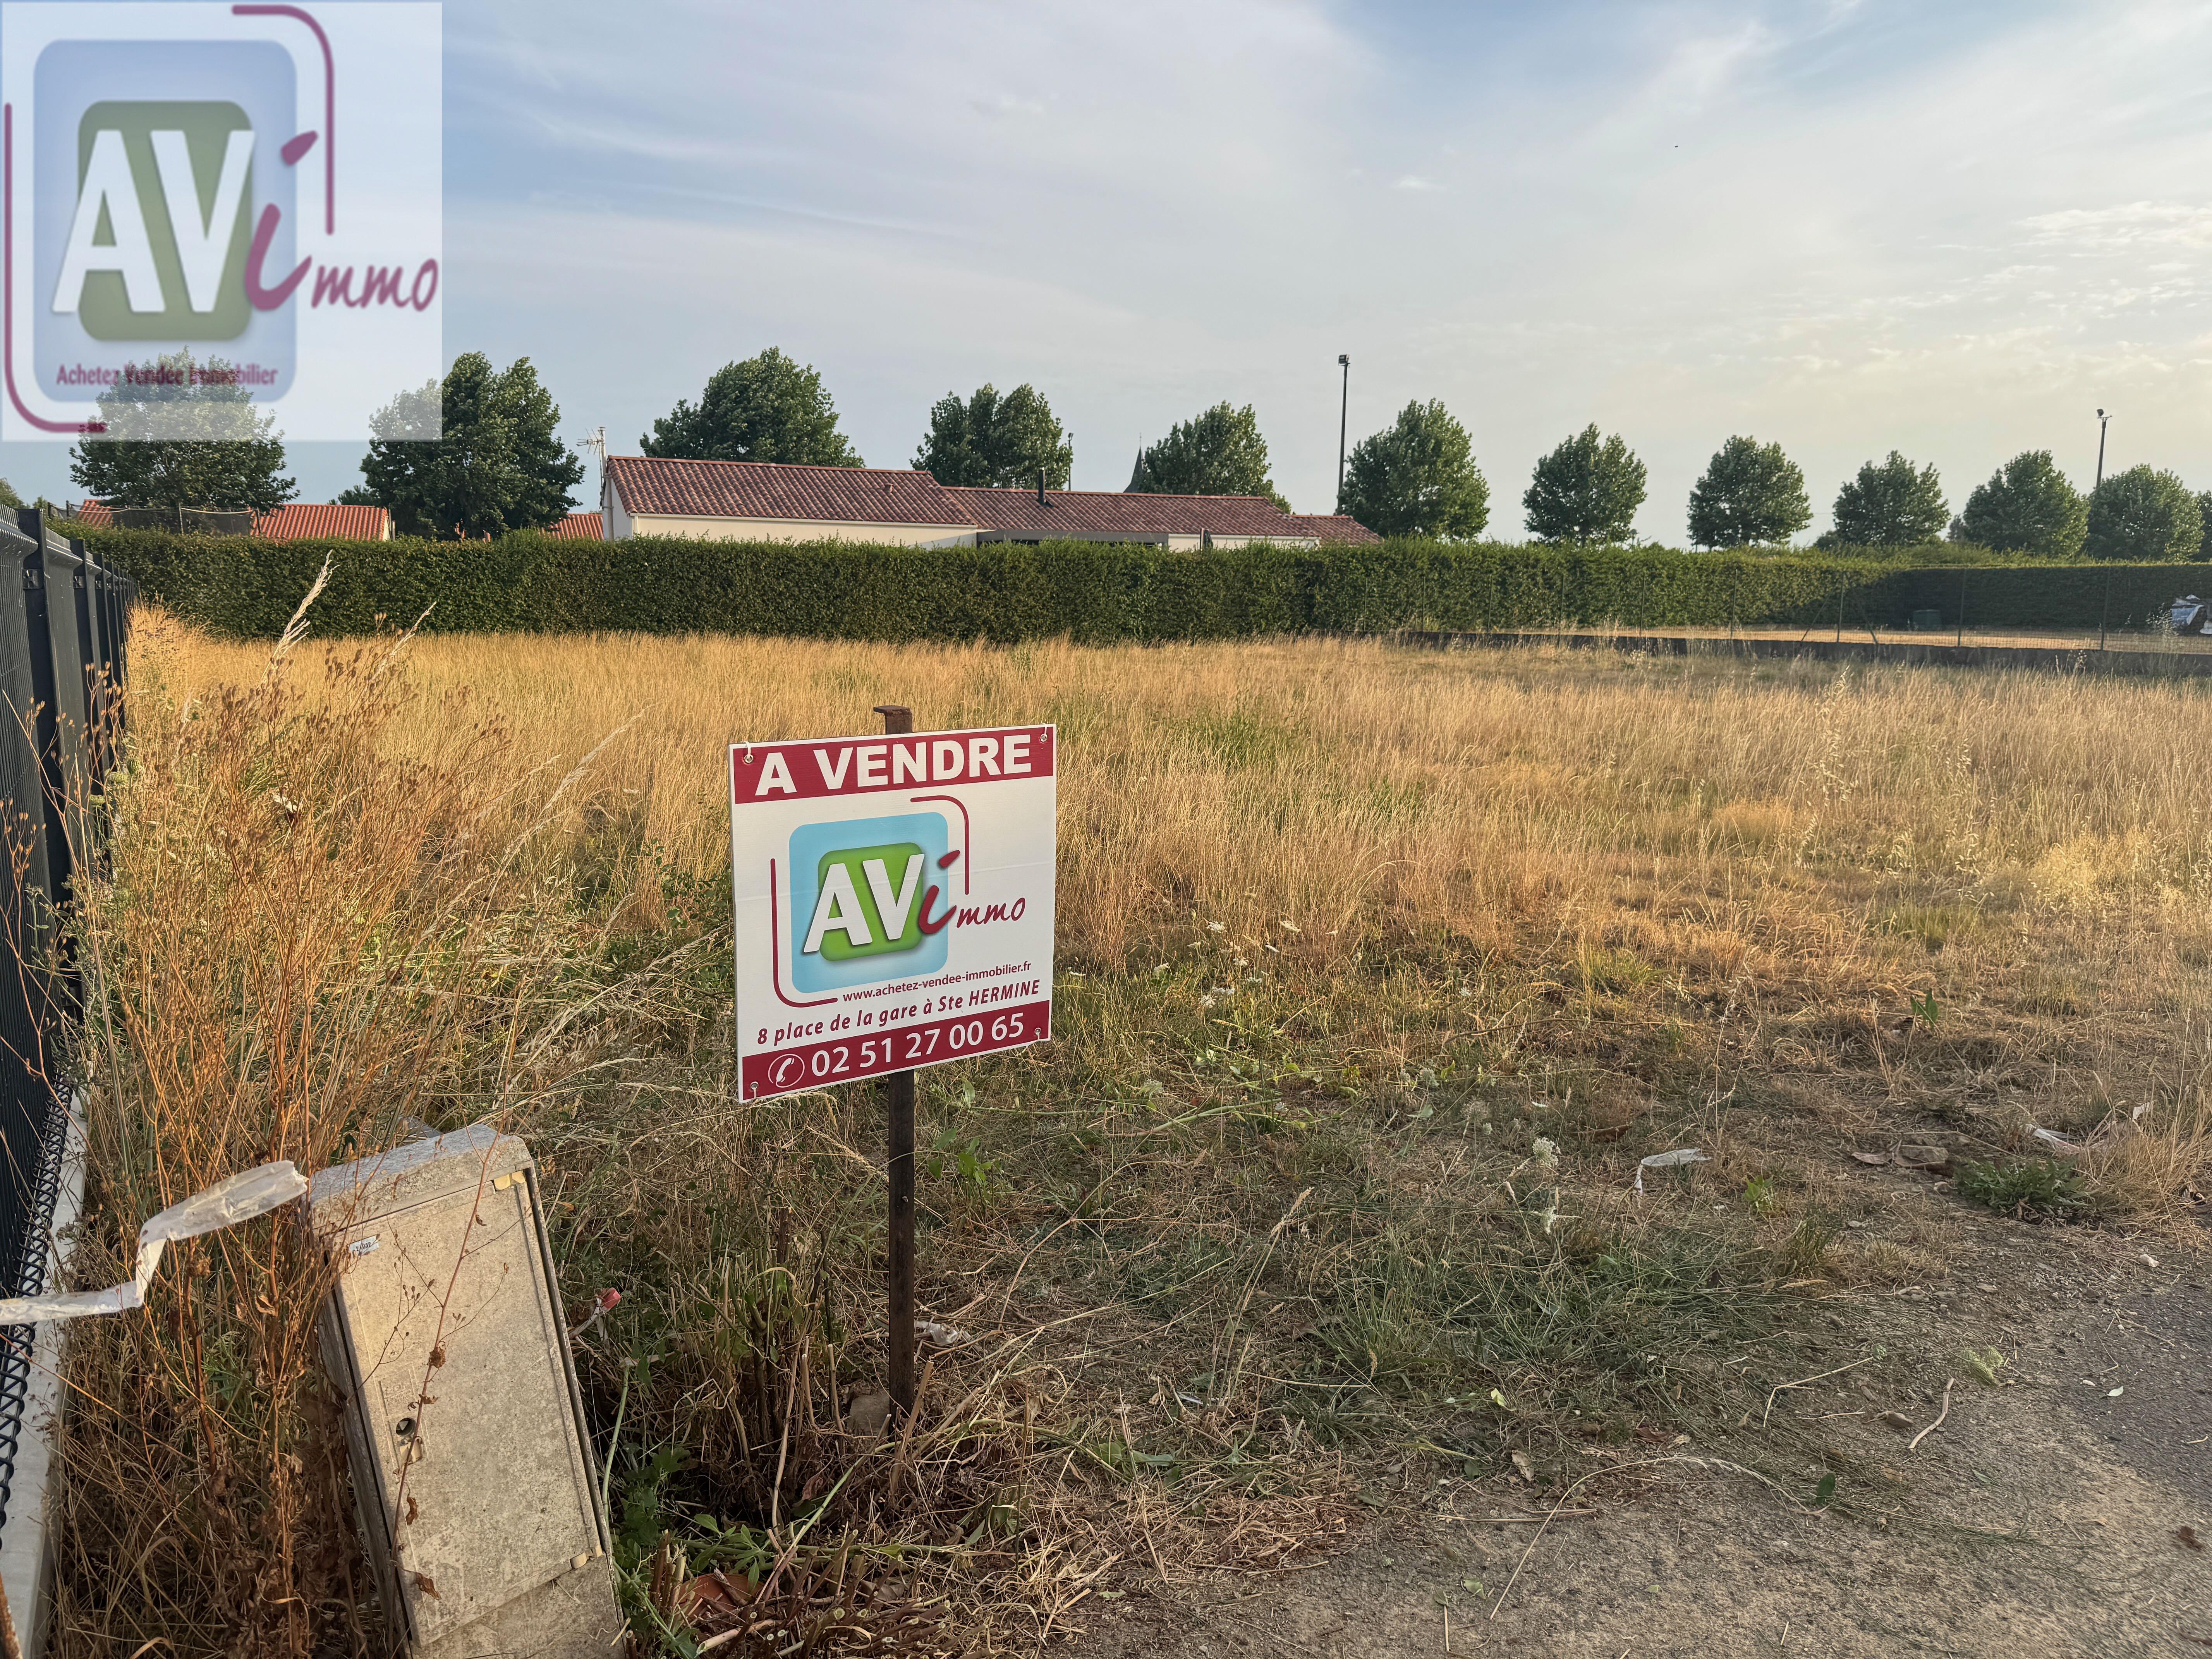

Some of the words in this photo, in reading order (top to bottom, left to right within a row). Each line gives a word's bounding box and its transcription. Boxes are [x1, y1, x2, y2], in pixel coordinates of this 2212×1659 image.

[755, 752, 797, 796] A
[813, 734, 1031, 790] VENDRE
[757, 1028, 768, 1044] 8
[774, 1022, 823, 1046] place
[830, 1013, 850, 1032] de
[857, 1010, 872, 1027] la
[879, 1005, 917, 1027] gare
[923, 998, 933, 1015] à
[938, 996, 963, 1012] Ste
[969, 979, 1040, 1006] HERMINE
[843, 961, 1031, 1002] www.achetez-vendee-immobilier.fr
[811, 1046, 849, 1077] 02
[859, 1037, 891, 1068] 51
[905, 1028, 940, 1059] 27
[949, 1020, 984, 1049] 00
[991, 1012, 1024, 1041] 65
